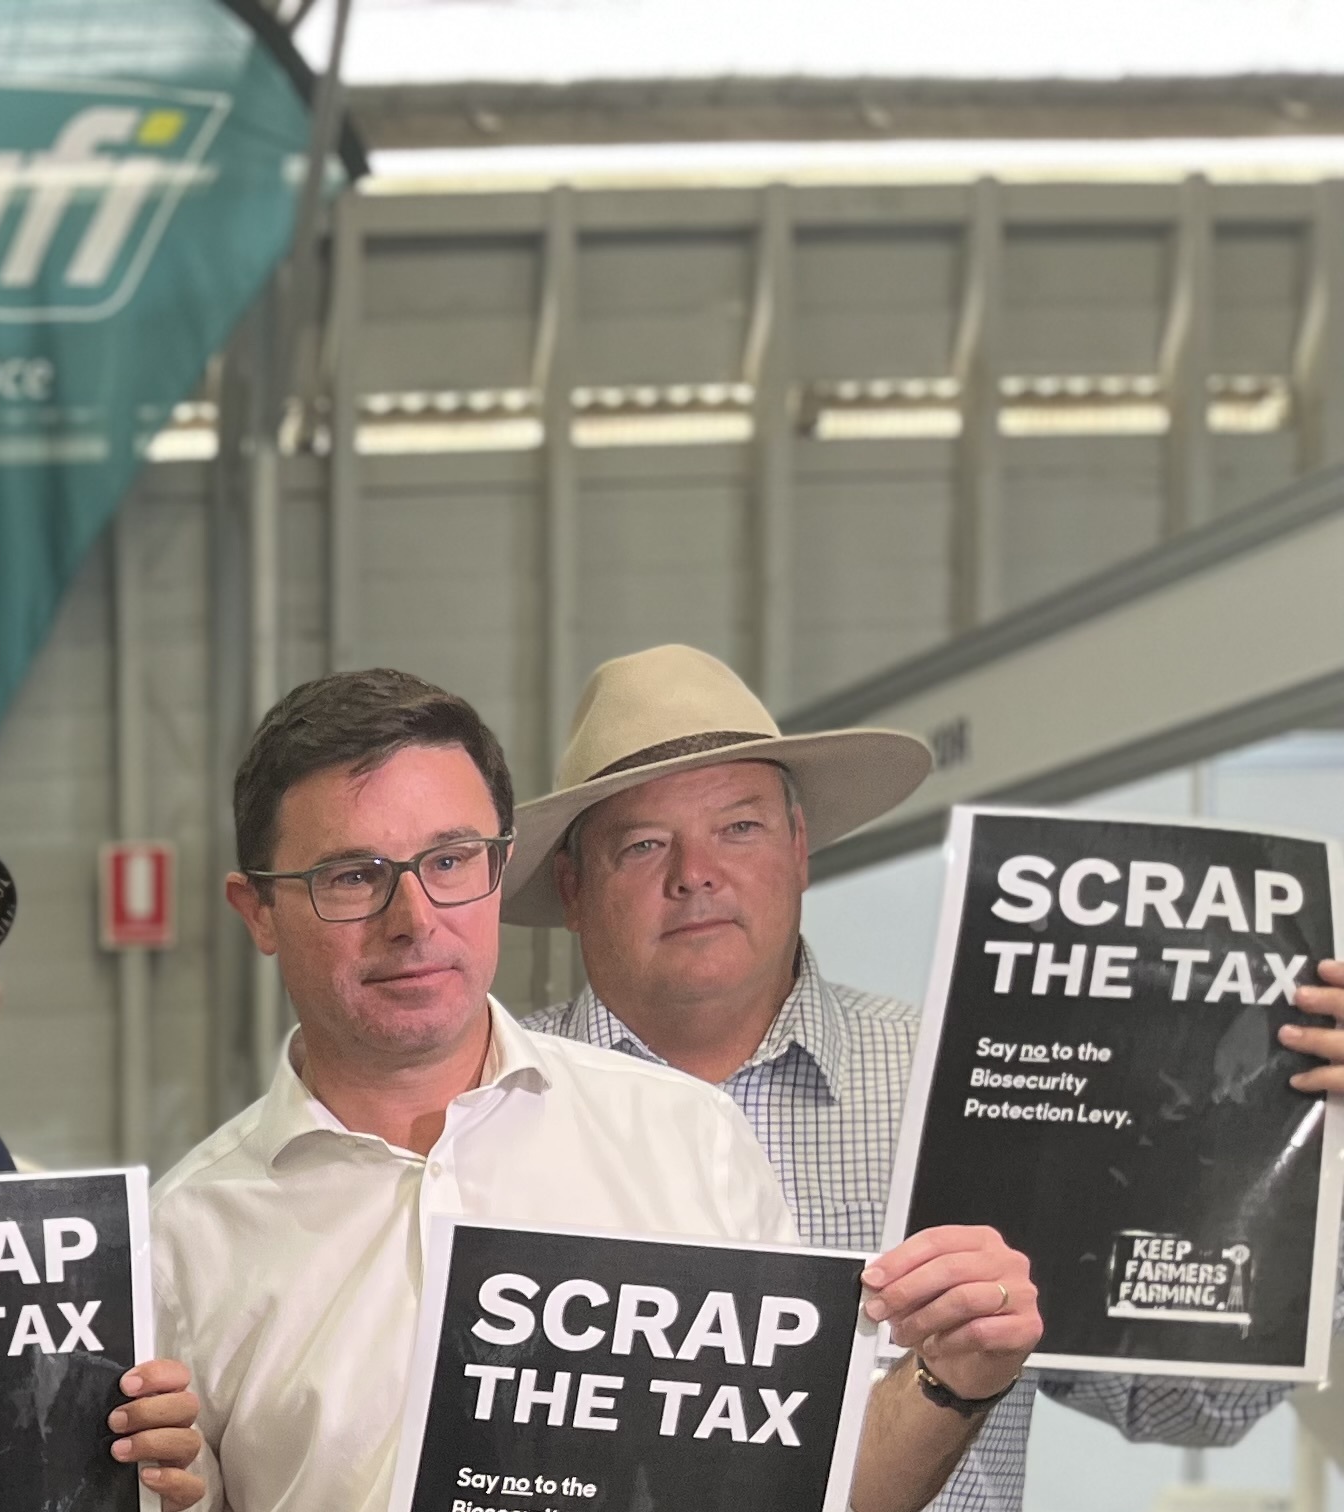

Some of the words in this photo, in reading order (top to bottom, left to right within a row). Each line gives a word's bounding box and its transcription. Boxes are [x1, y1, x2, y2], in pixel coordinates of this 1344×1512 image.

[990, 854, 1305, 935] SCRAP
[984, 940, 1138, 999] THE
[1161, 947, 1309, 1006] TAX
[976, 1036, 1018, 1063] Say
[1019, 1044, 1049, 1062] no
[1051, 1041, 1073, 1060] to
[1078, 1041, 1112, 1062] the
[970, 1067, 1088, 1096] Biosecurity
[964, 1098, 1074, 1122] Protection
[1077, 1104, 1133, 1130] Levy.
[1133, 1238, 1192, 1261] KEEP
[1125, 1260, 1227, 1285] FARMERS
[470, 1272, 821, 1368] SCRAP
[464, 1363, 625, 1432] THE
[649, 1379, 809, 1447] TAX
[457, 1467, 500, 1494] Say
[501, 1476, 532, 1495] no
[534, 1475, 558, 1494] to
[561, 1477, 598, 1498] the
